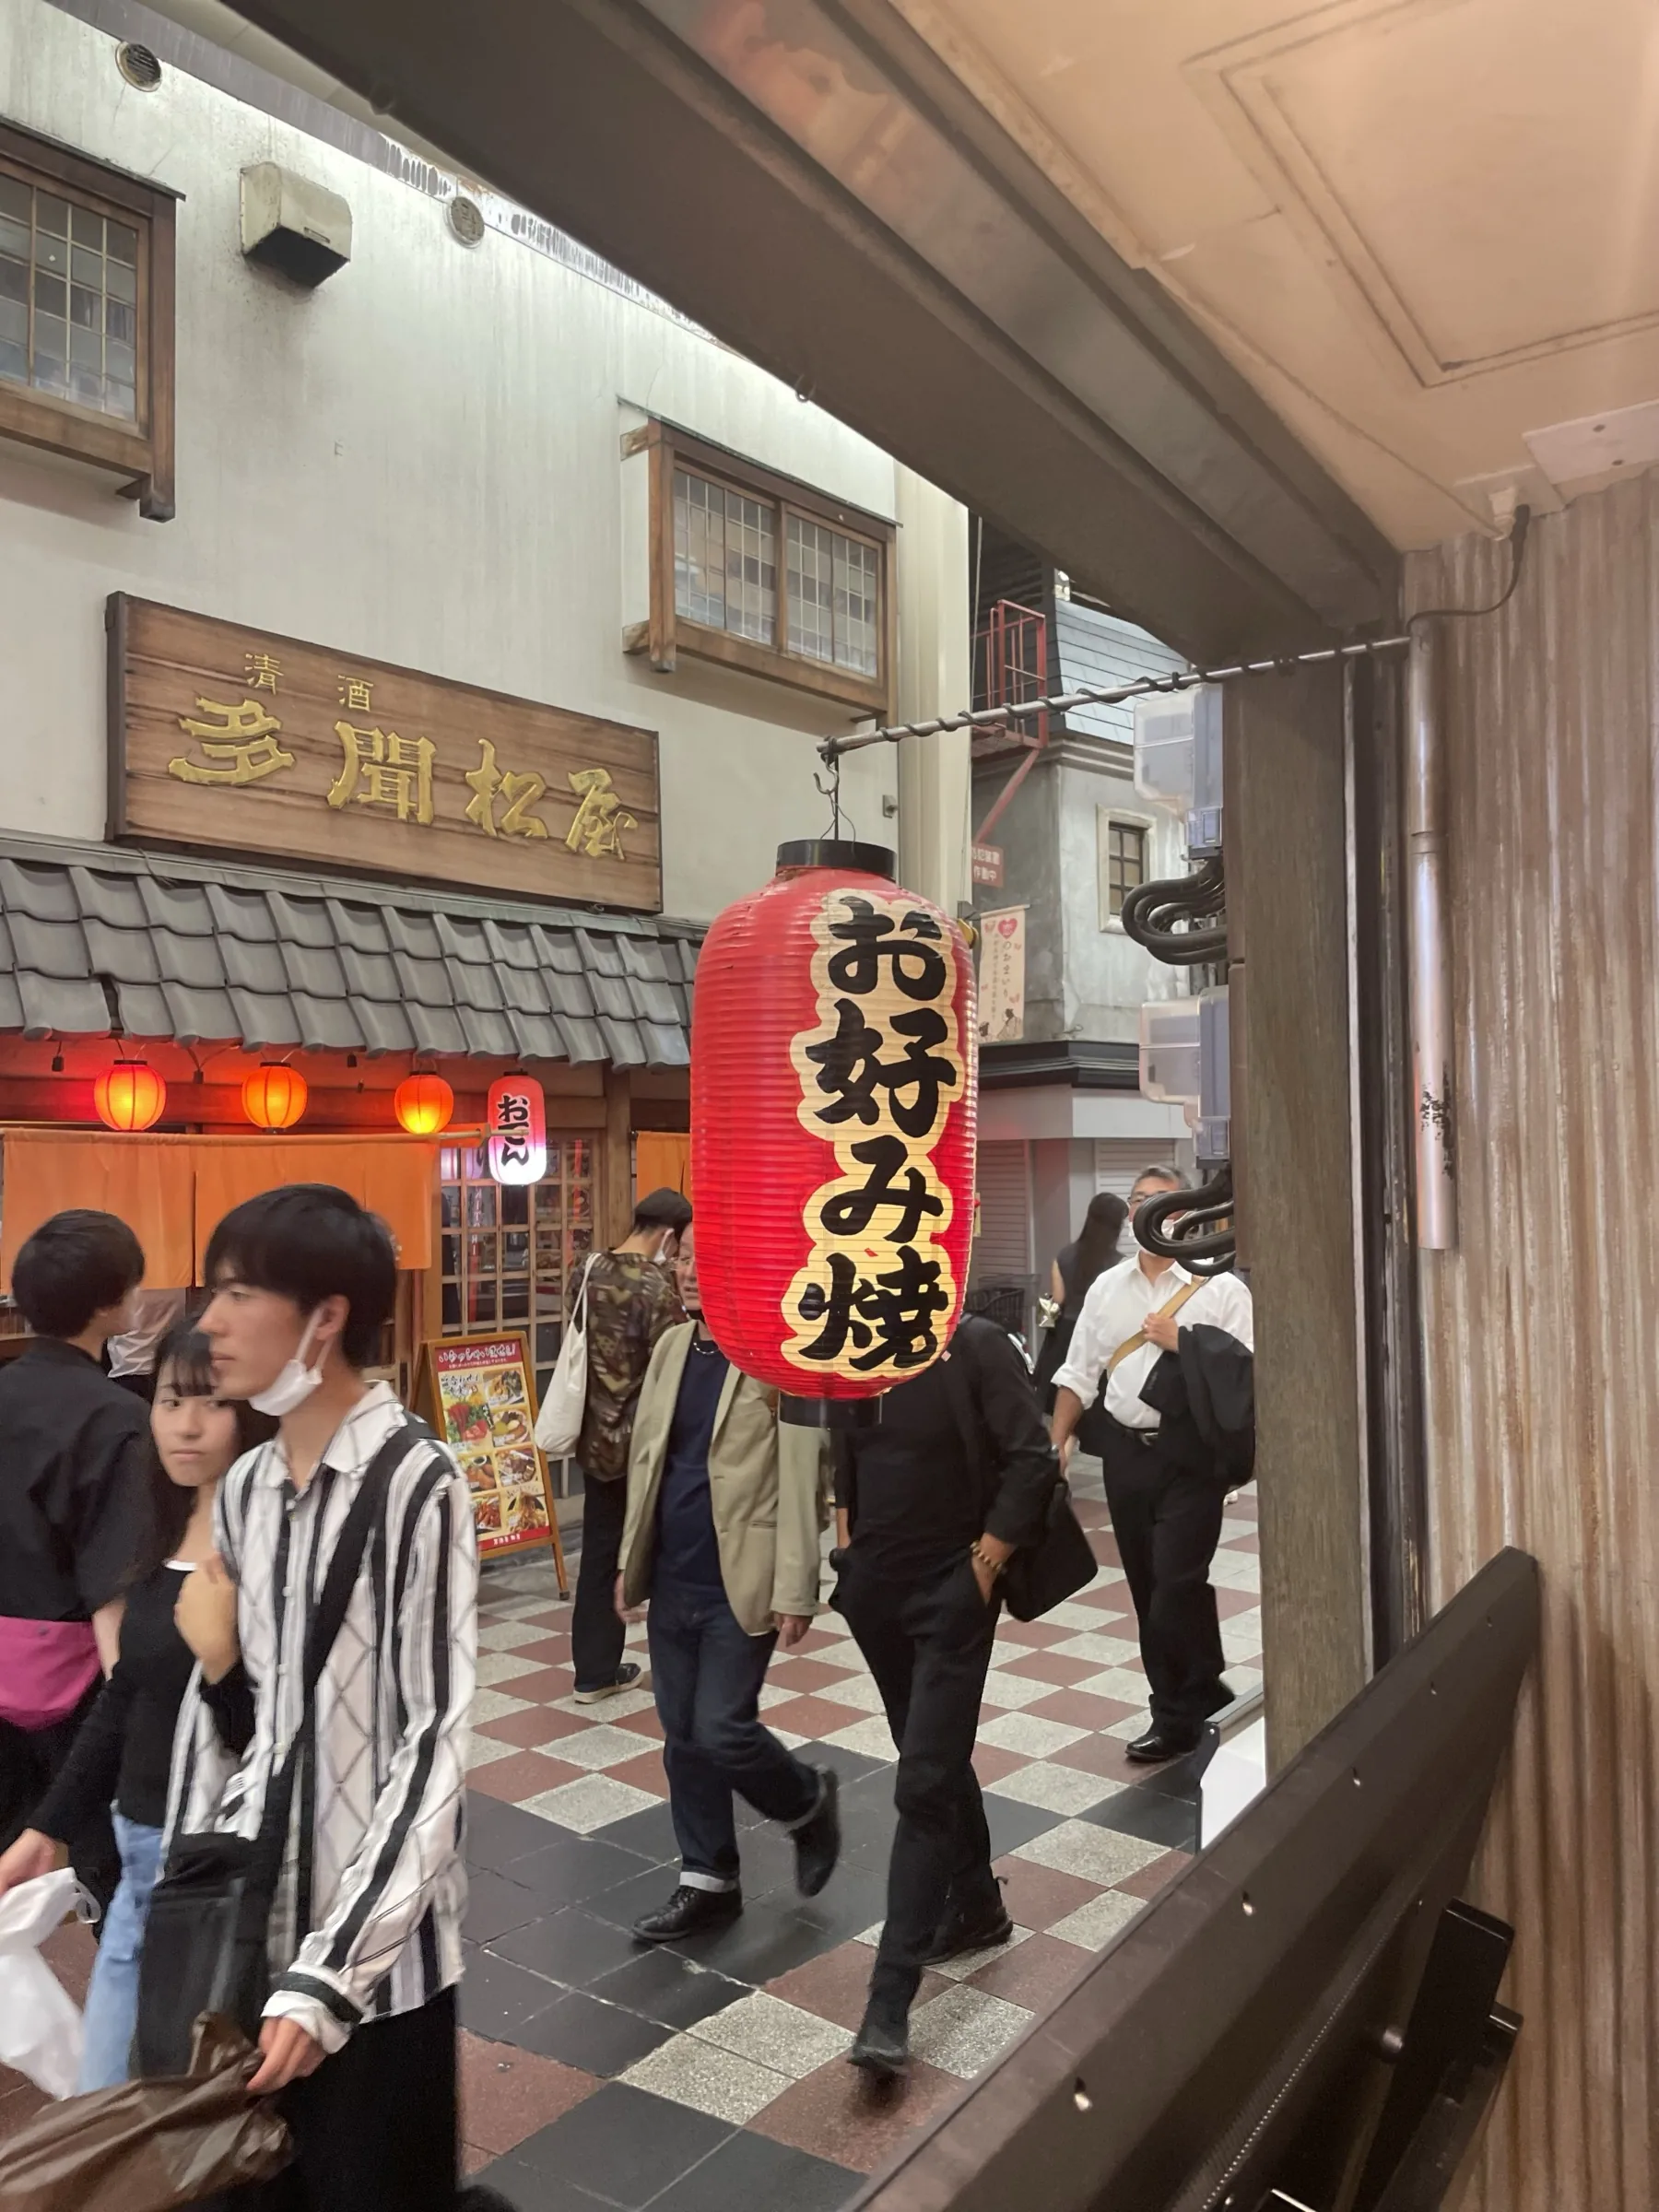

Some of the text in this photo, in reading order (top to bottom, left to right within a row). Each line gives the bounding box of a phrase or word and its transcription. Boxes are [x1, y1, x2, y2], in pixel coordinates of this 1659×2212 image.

[244, 653, 373, 712] 清酒
[168, 695, 638, 860] 多聞松屋
[800, 895, 957, 1370] お好み焼
